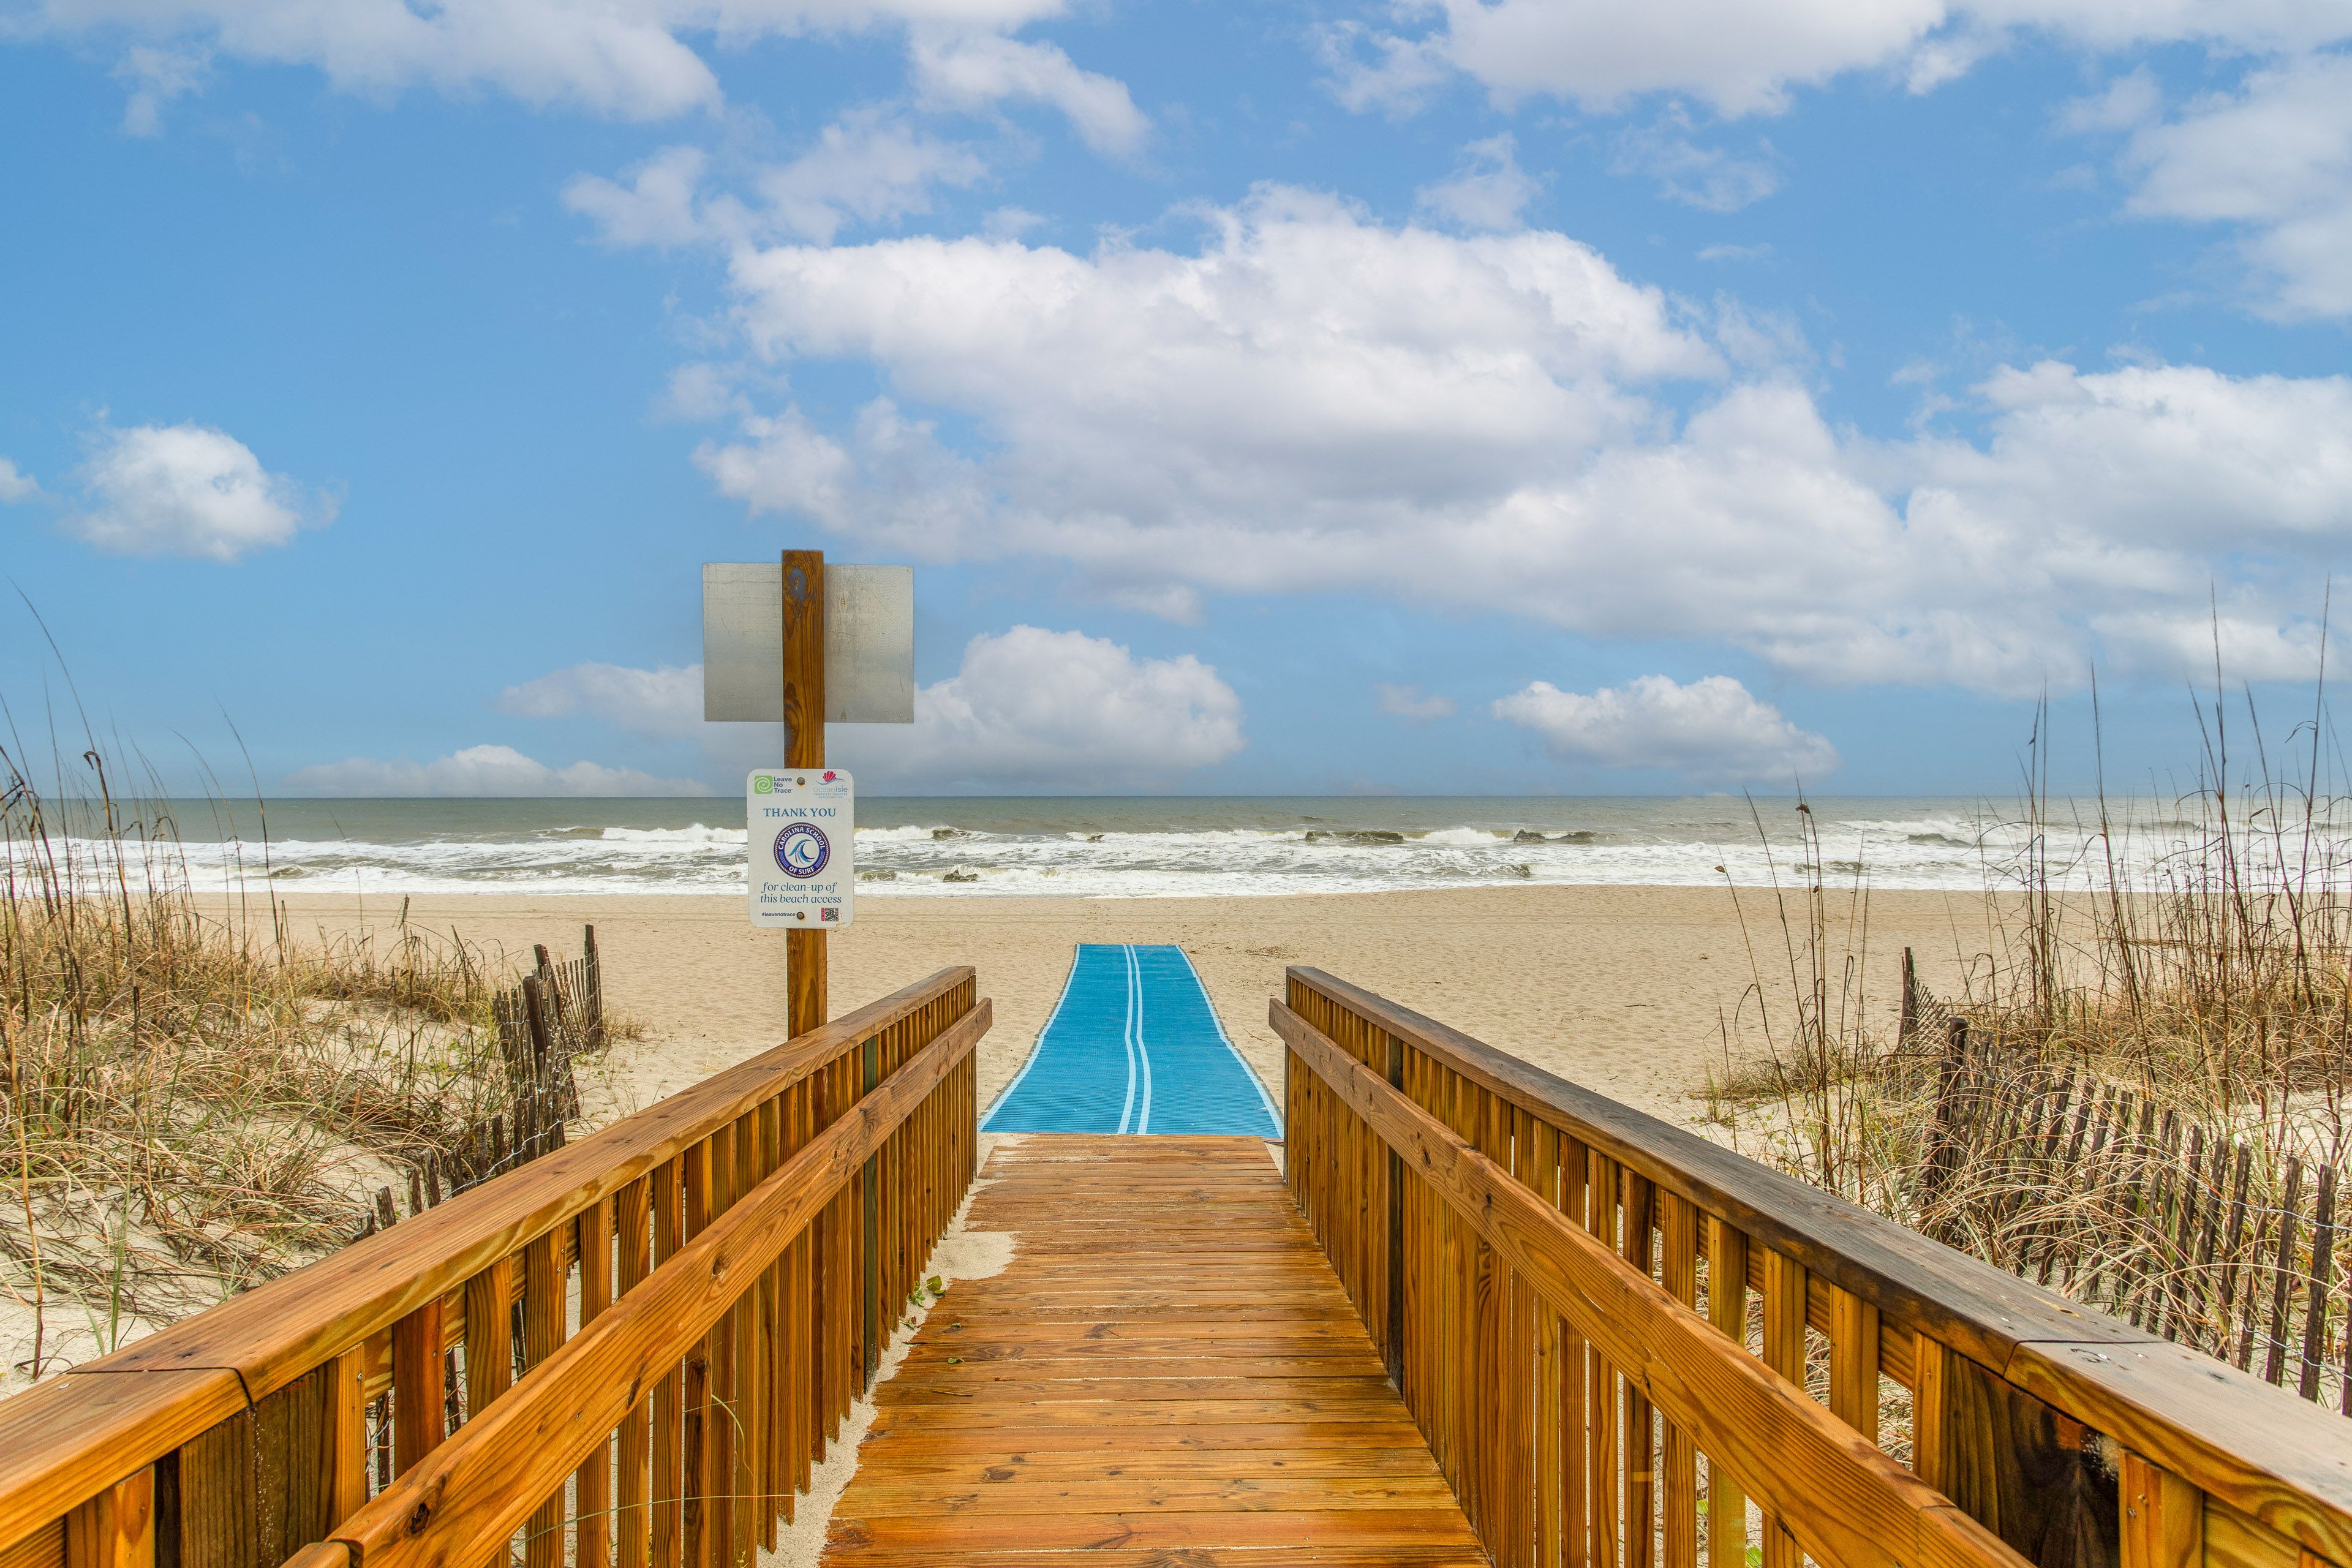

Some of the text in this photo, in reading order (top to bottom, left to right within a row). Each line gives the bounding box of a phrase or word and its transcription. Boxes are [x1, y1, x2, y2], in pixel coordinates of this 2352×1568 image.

[763, 808, 837, 817] THANK YOU
[778, 826, 826, 850] CAROLINA SCHOOL
[798, 866, 815, 875] SURF
[761, 881, 837, 894] for clean-up of
[760, 894, 777, 903] this
[780, 894, 809, 903] beach
